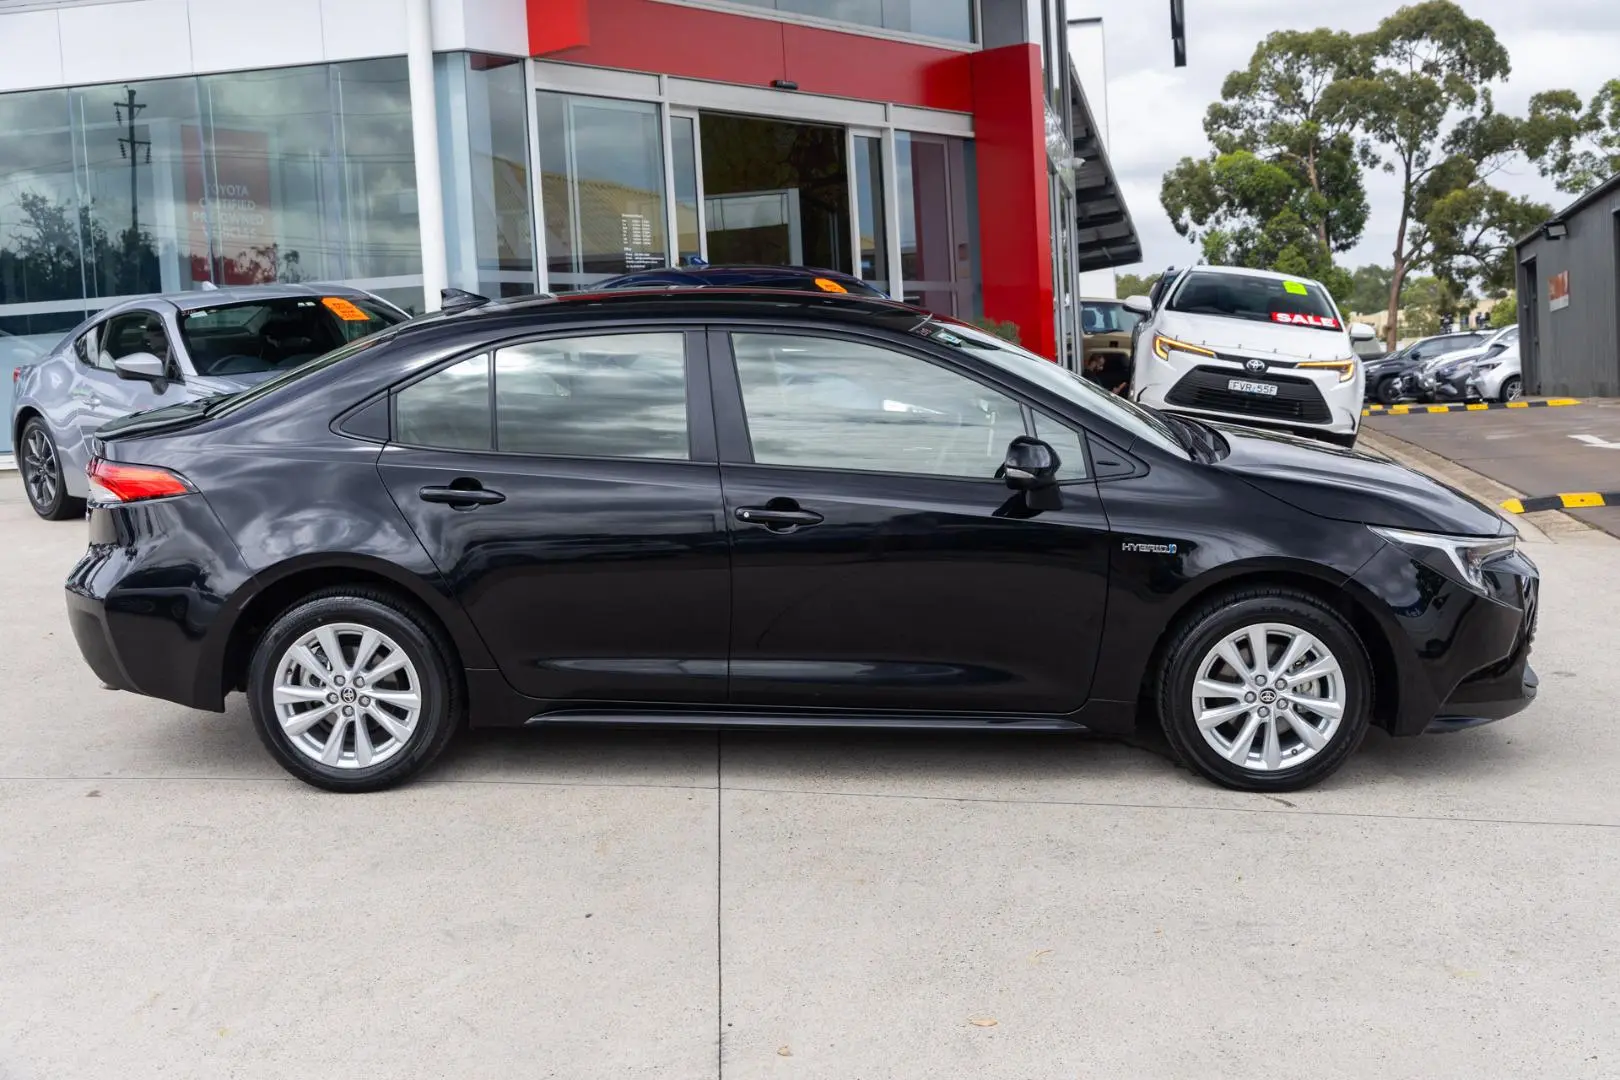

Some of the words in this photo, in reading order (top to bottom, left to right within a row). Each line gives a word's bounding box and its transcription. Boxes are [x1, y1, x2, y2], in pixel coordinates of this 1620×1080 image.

[199, 197, 256, 210] CTIFIED
[193, 211, 264, 225] PROWNED
[202, 226, 257, 240] VHICLES
[1276, 313, 1336, 327] SALE
[1122, 543, 1168, 553] HYBRID
